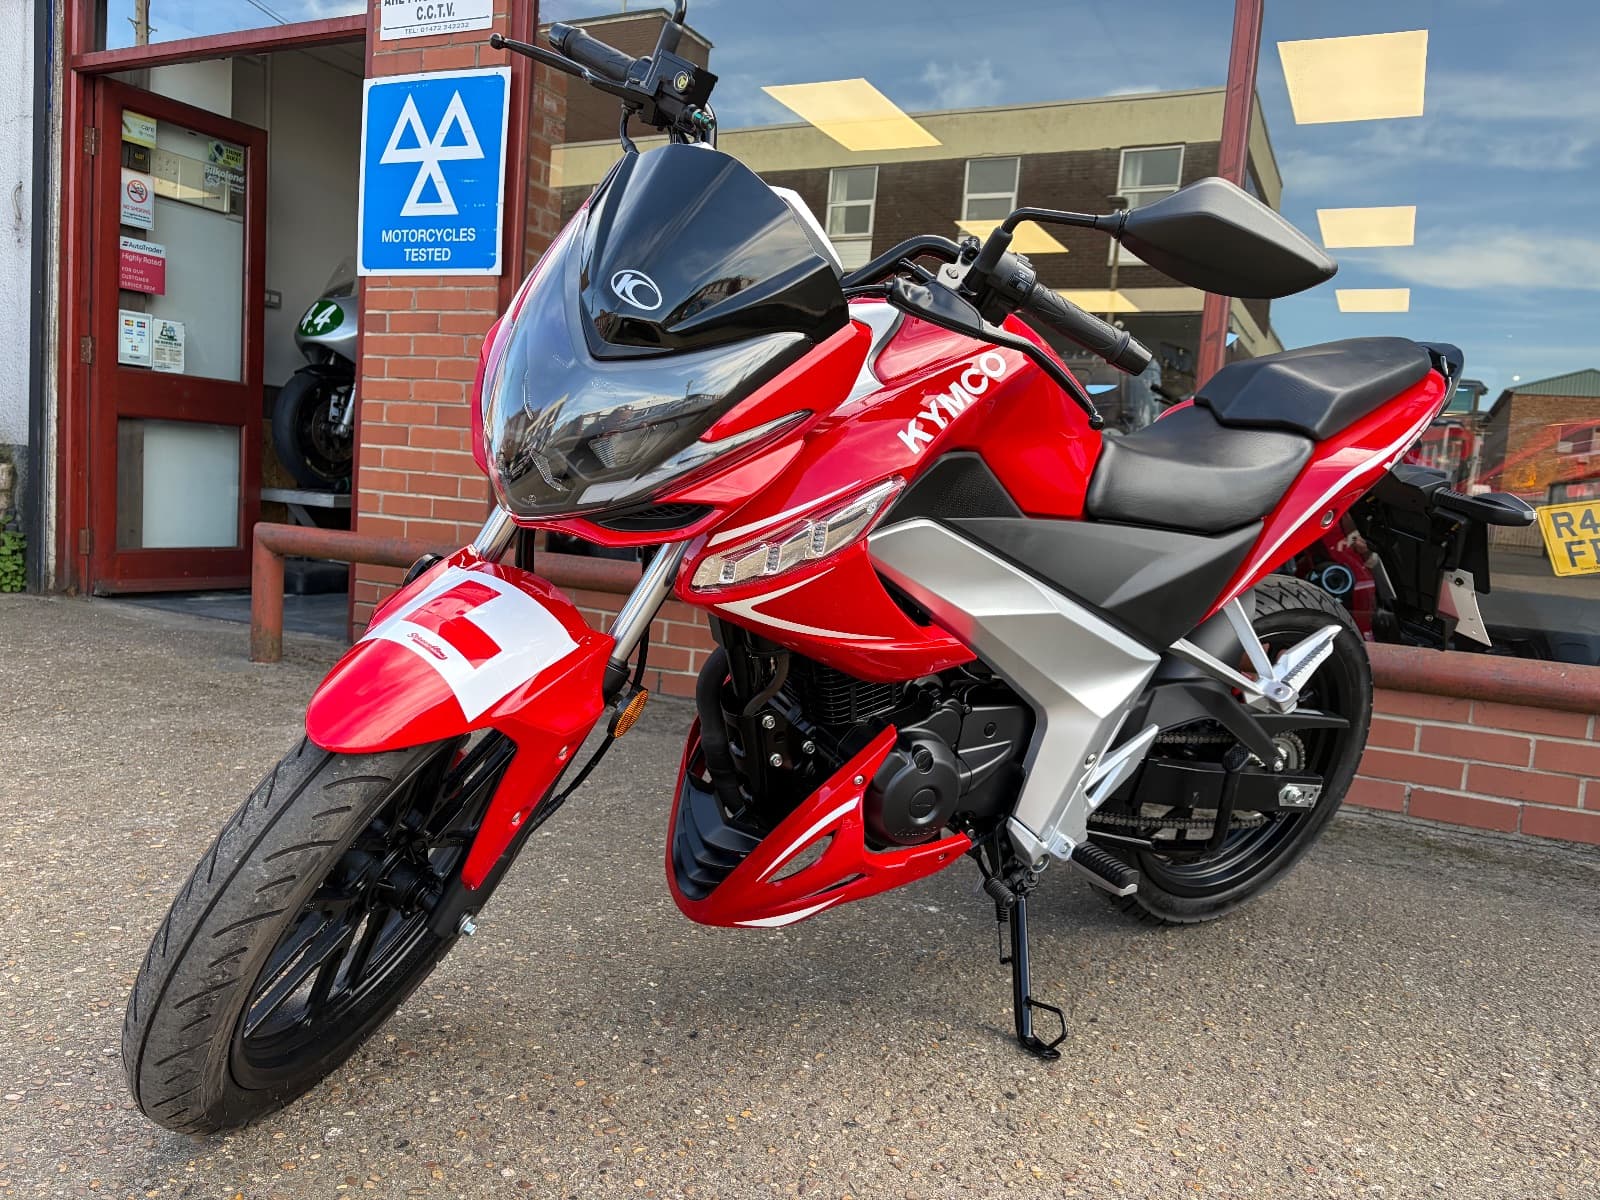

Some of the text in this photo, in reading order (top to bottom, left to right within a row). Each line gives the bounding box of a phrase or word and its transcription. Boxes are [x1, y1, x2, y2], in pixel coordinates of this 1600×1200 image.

[416, 2, 455, 20] C.C.T.V.
[381, 227, 476, 243] MOTORCYCLES
[121, 252, 162, 267] Highly Rated
[403, 247, 451, 262] TESTED
[897, 352, 1006, 455] KYMCO
